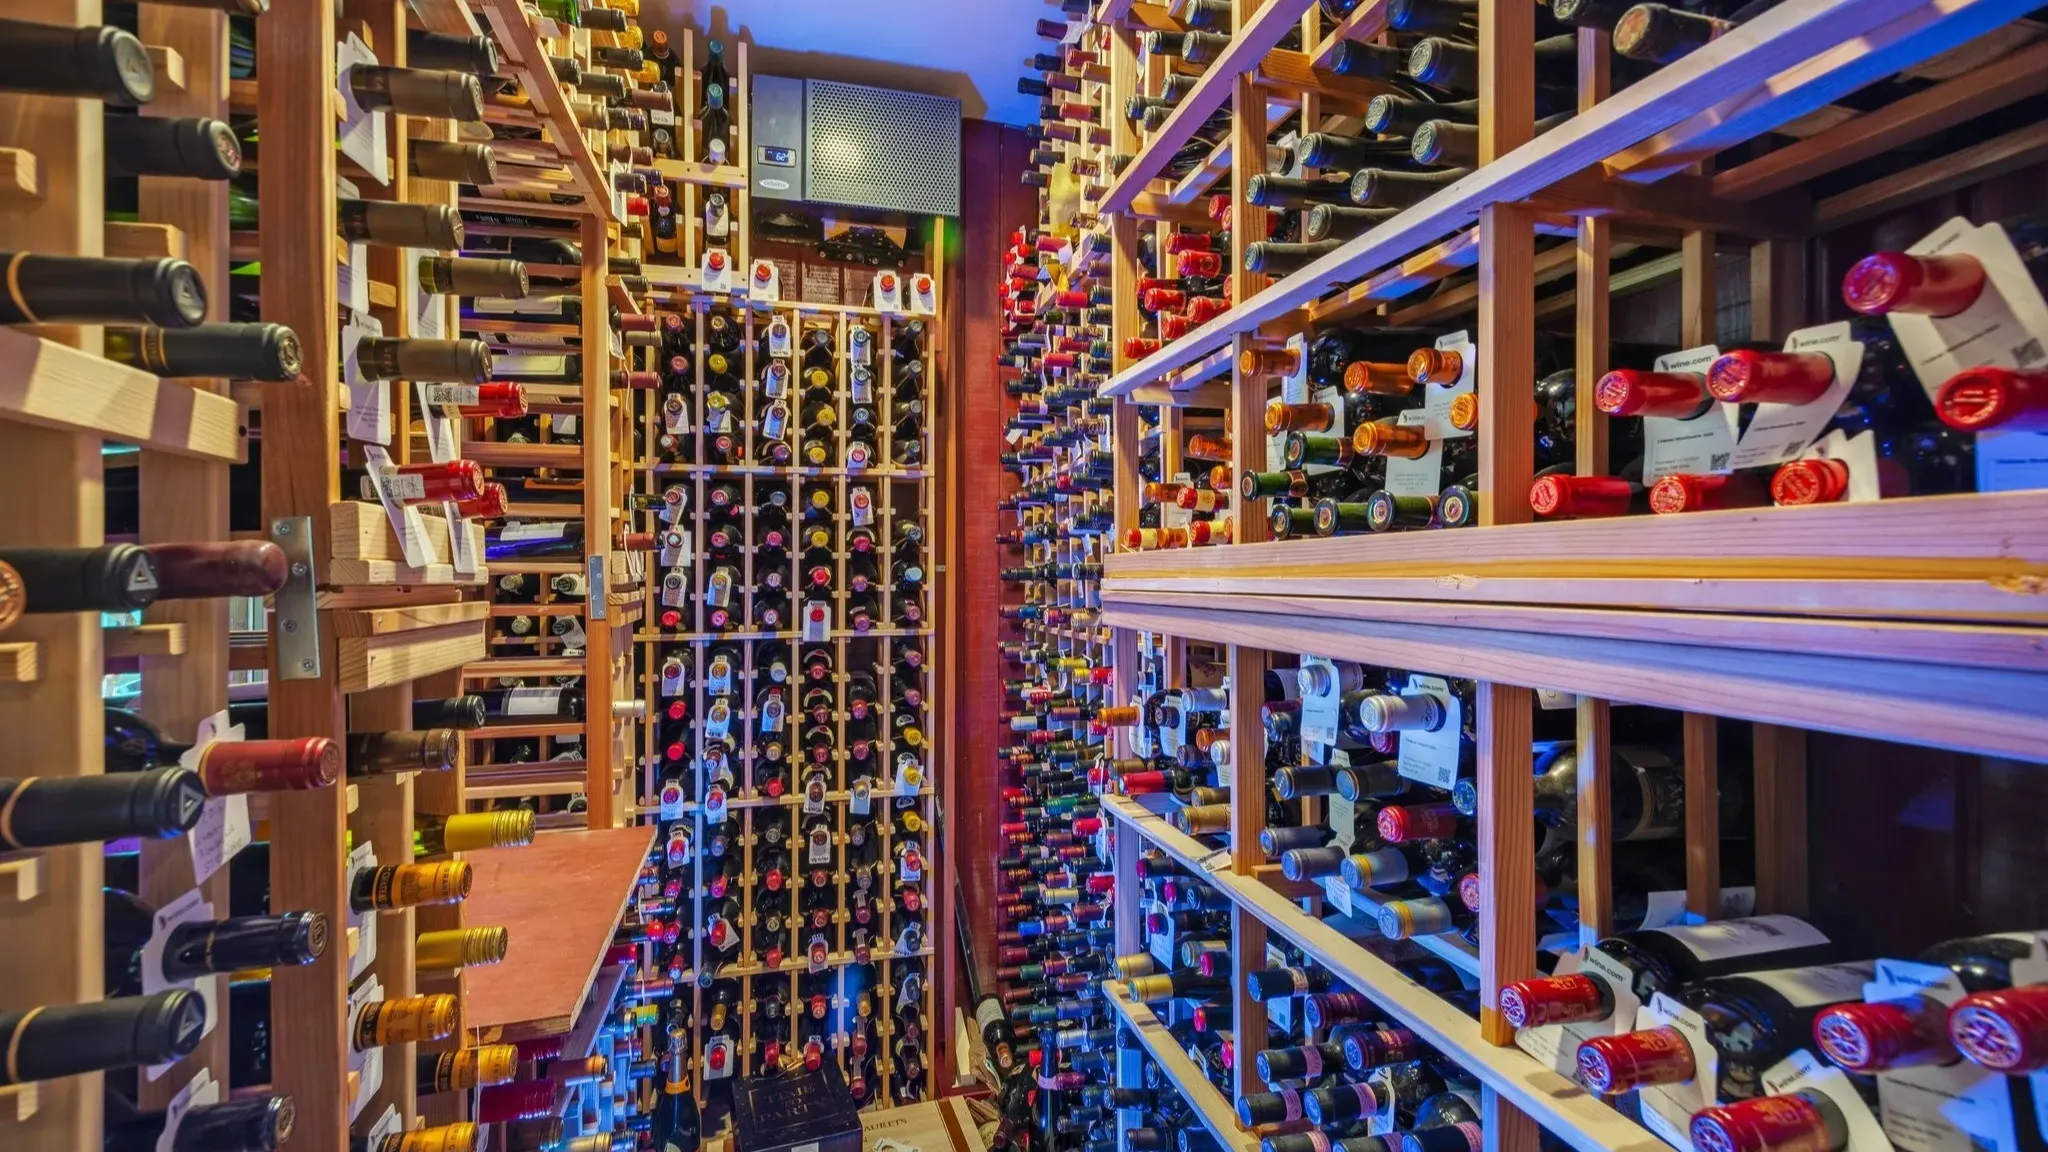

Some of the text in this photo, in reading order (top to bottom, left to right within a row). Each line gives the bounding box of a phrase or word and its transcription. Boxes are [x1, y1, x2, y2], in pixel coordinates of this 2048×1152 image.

[1669, 355, 1713, 370] wine.com
[1418, 683, 1444, 693] wine.com
[1588, 955, 1624, 982] wine.com
[1662, 1007, 1698, 1031] wine.com
[1778, 1063, 1812, 1089] wine.com
